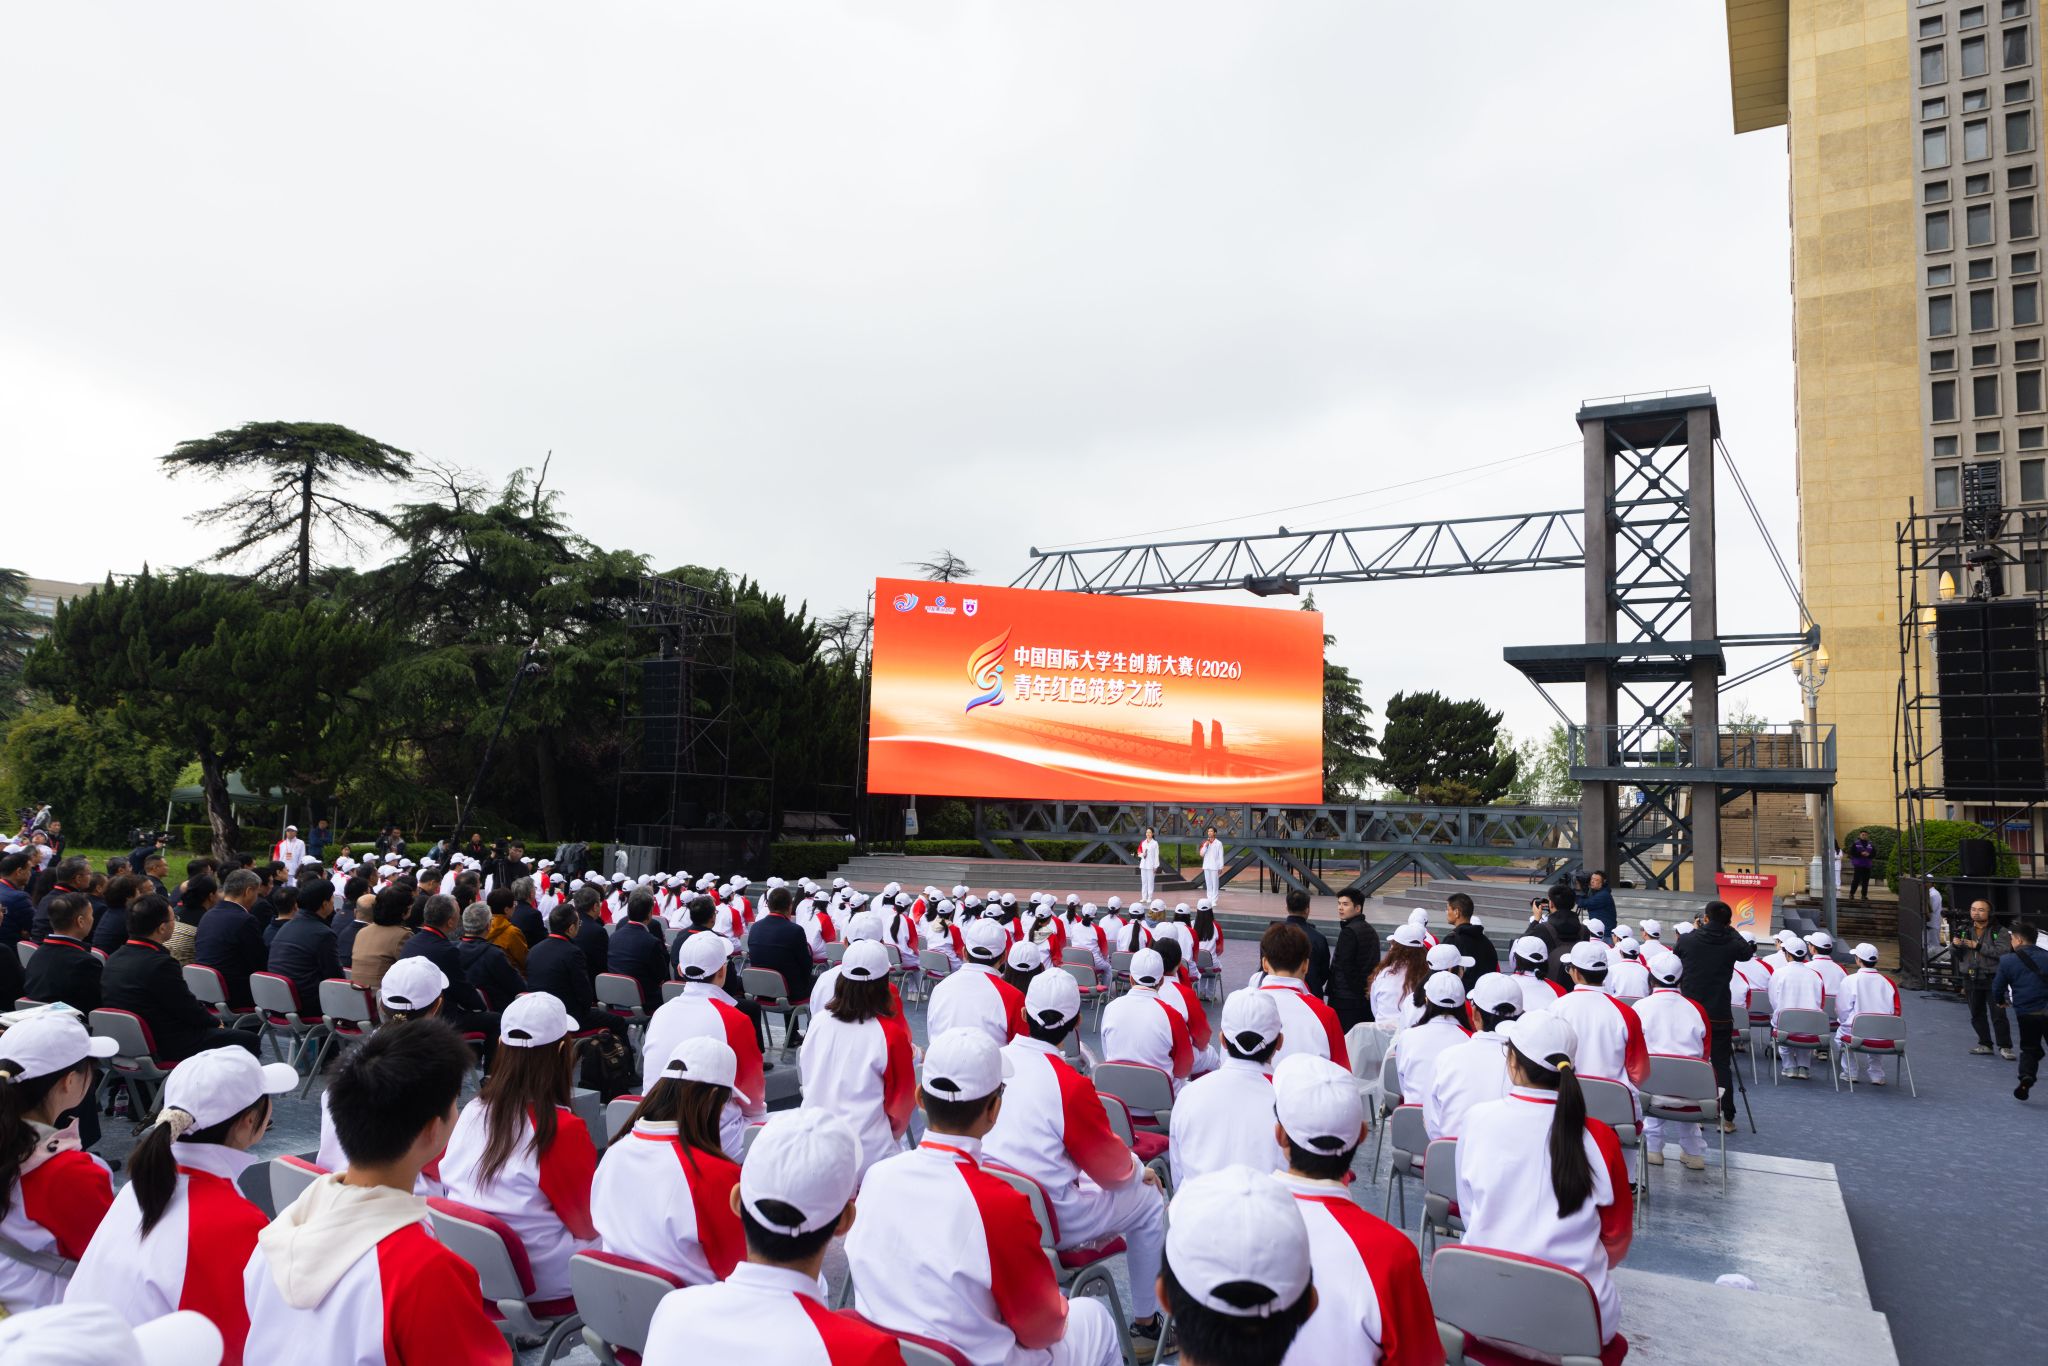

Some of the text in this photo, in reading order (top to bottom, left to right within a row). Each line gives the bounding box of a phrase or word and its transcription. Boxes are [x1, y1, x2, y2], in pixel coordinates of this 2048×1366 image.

[1014, 674, 1163, 707] 青年红色筑梦之旅
